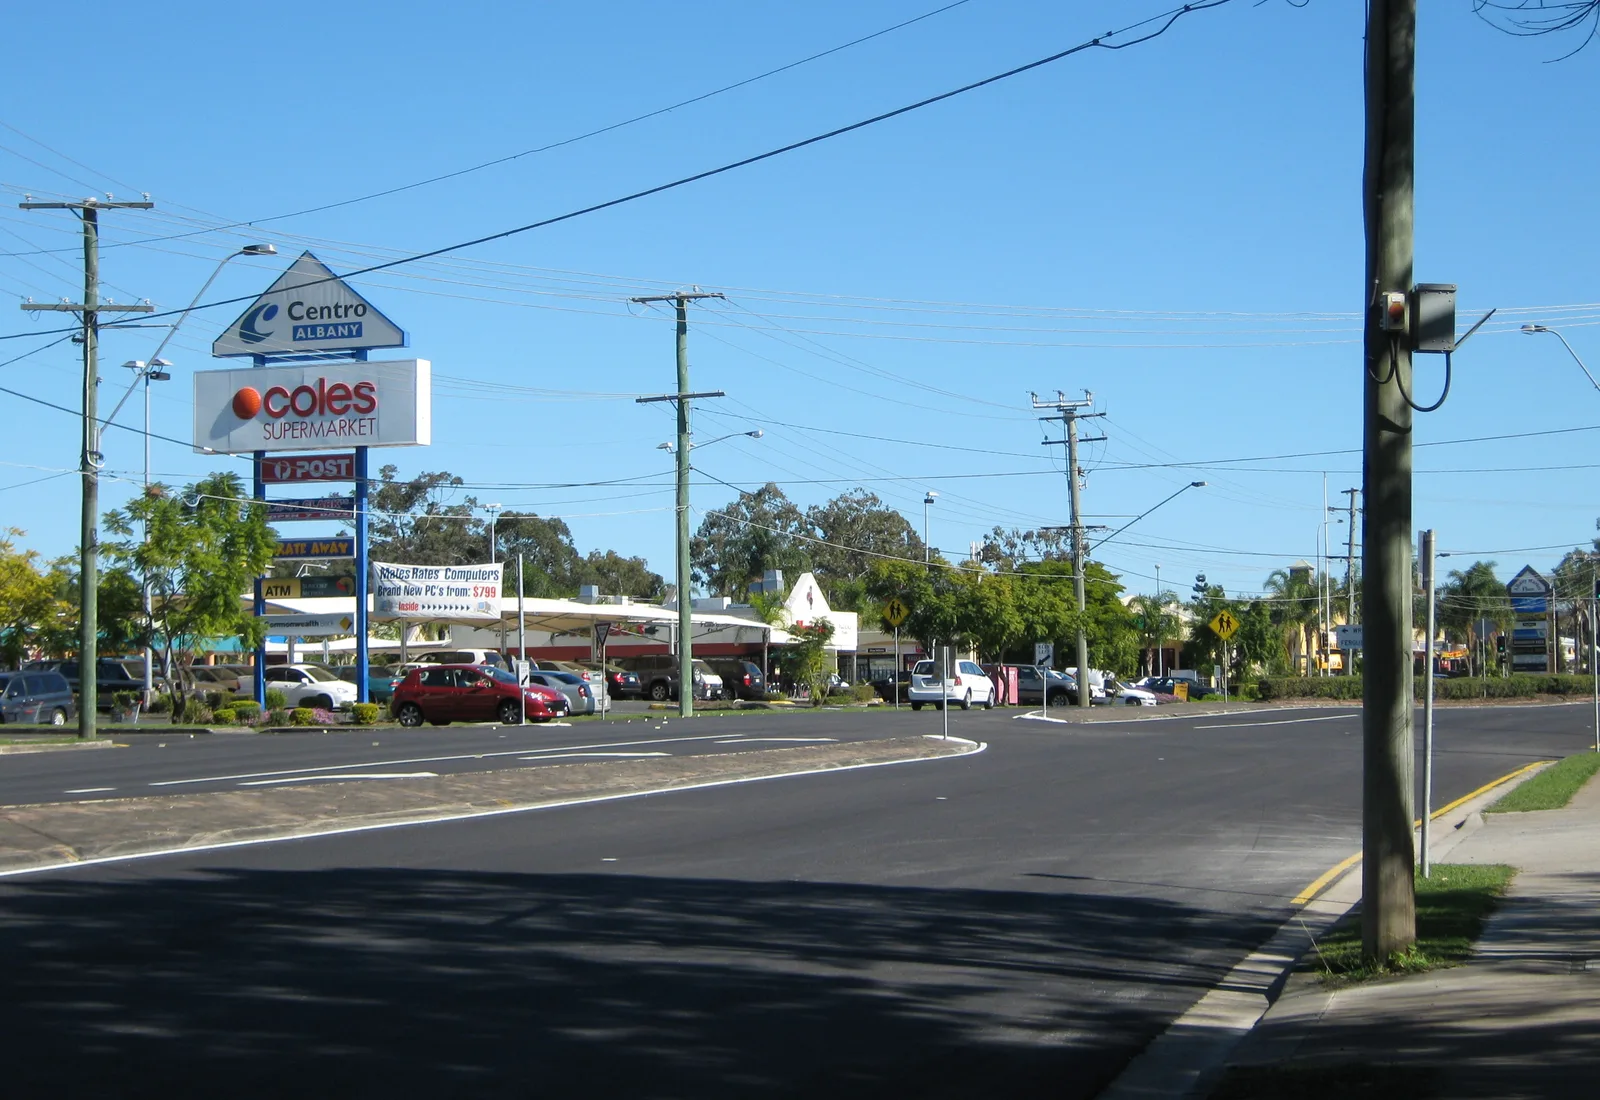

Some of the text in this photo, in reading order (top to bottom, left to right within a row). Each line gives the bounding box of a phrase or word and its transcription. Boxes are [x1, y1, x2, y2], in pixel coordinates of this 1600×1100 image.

[287, 301, 367, 321] Centro
[295, 323, 360, 339] ALBANY
[263, 377, 378, 418] coles
[263, 418, 376, 440] SUPERMARKET
[296, 459, 350, 478] POST
[310, 541, 349, 554] AWAY
[412, 567, 439, 580] Rates
[444, 567, 499, 582] Computers
[265, 585, 291, 597] ATM
[377, 585, 496, 598] Brand New PC's from: $799
[398, 601, 419, 611] Inside
